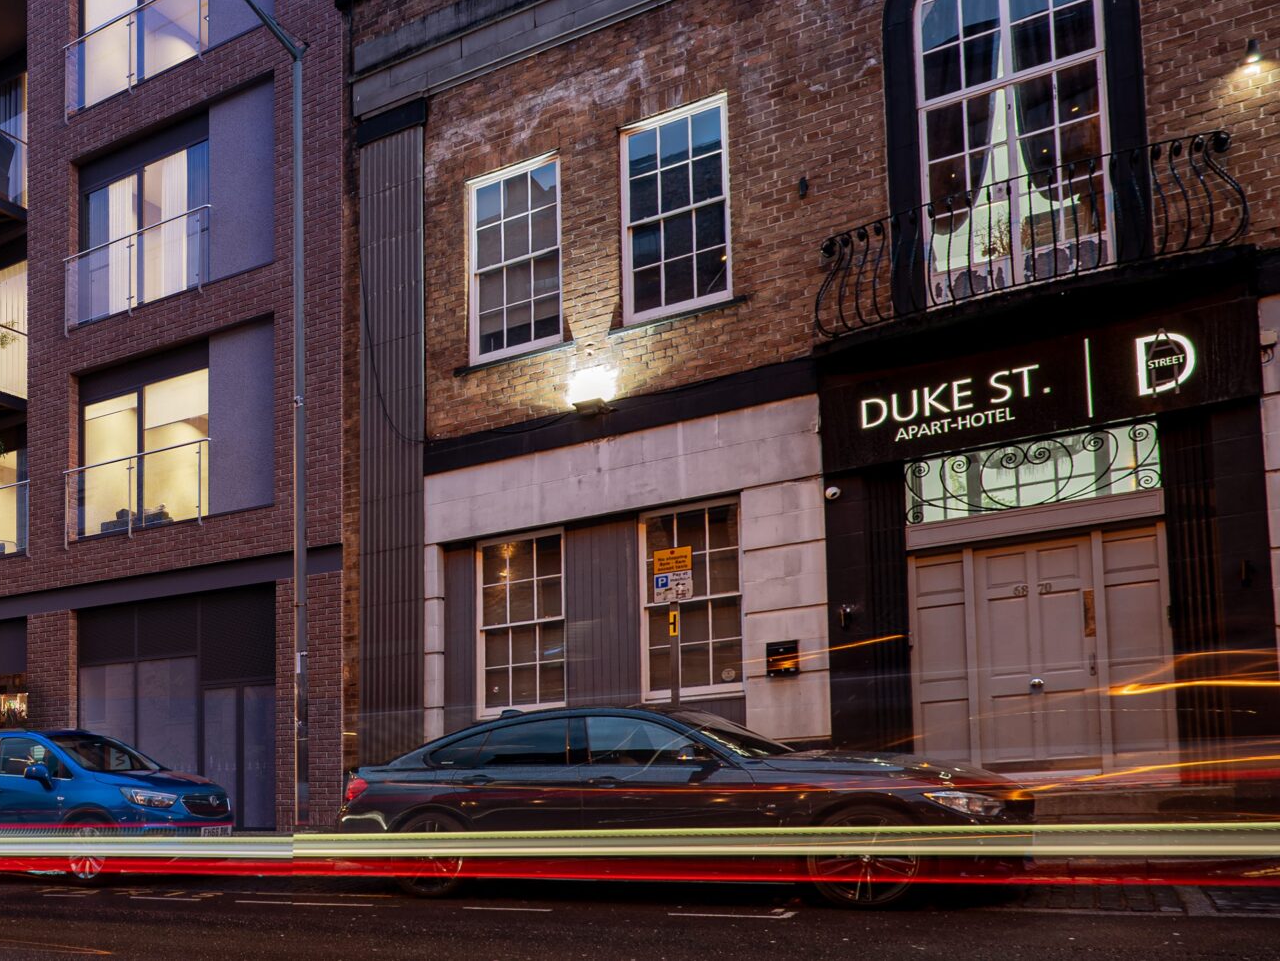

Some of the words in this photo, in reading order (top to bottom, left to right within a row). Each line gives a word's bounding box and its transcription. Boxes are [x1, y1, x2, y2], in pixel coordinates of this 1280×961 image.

[1147, 353, 1185, 370] STREET
[860, 378, 974, 430] DUKE
[989, 364, 1051, 404] ST.
[895, 407, 1015, 443] APART-HOTEL
[1036, 582, 1053, 595] 70
